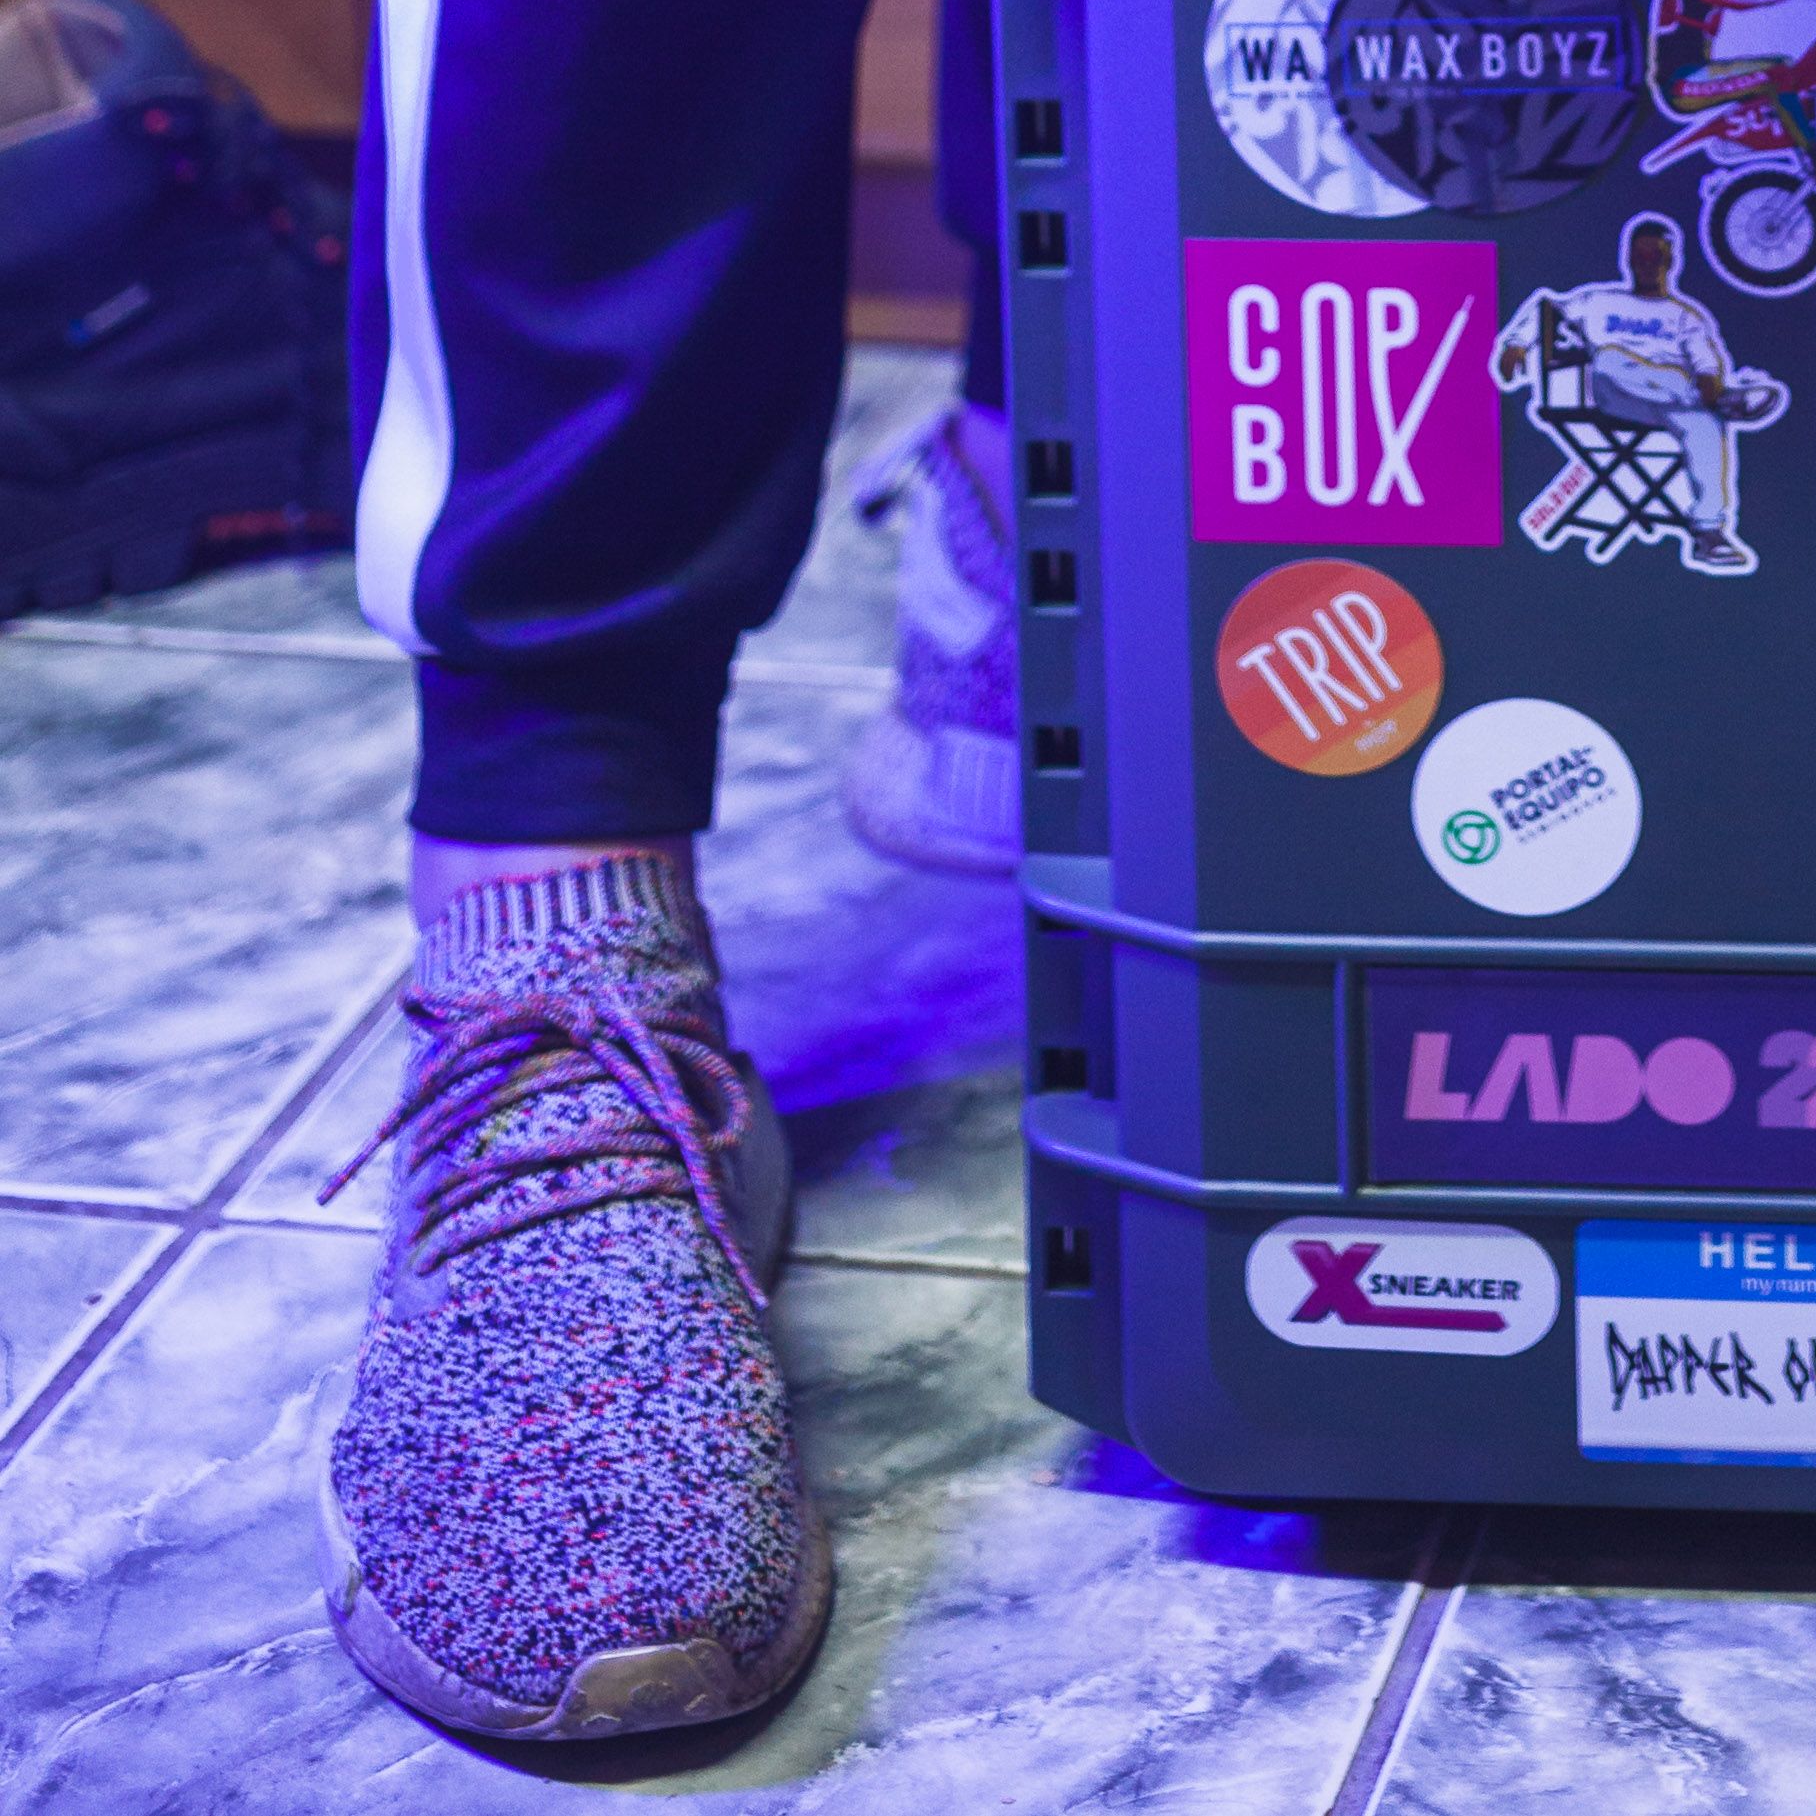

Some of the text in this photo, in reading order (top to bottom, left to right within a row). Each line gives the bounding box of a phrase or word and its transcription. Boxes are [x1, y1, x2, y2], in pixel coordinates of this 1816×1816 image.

[1354, 29, 1612, 83] WAX BOYZ
[1236, 590, 1403, 742] TRIP
[1404, 1030, 1737, 1126] LADO
[1370, 1273, 1522, 1303] SNEAKER
[1741, 1276, 1774, 1296] my
